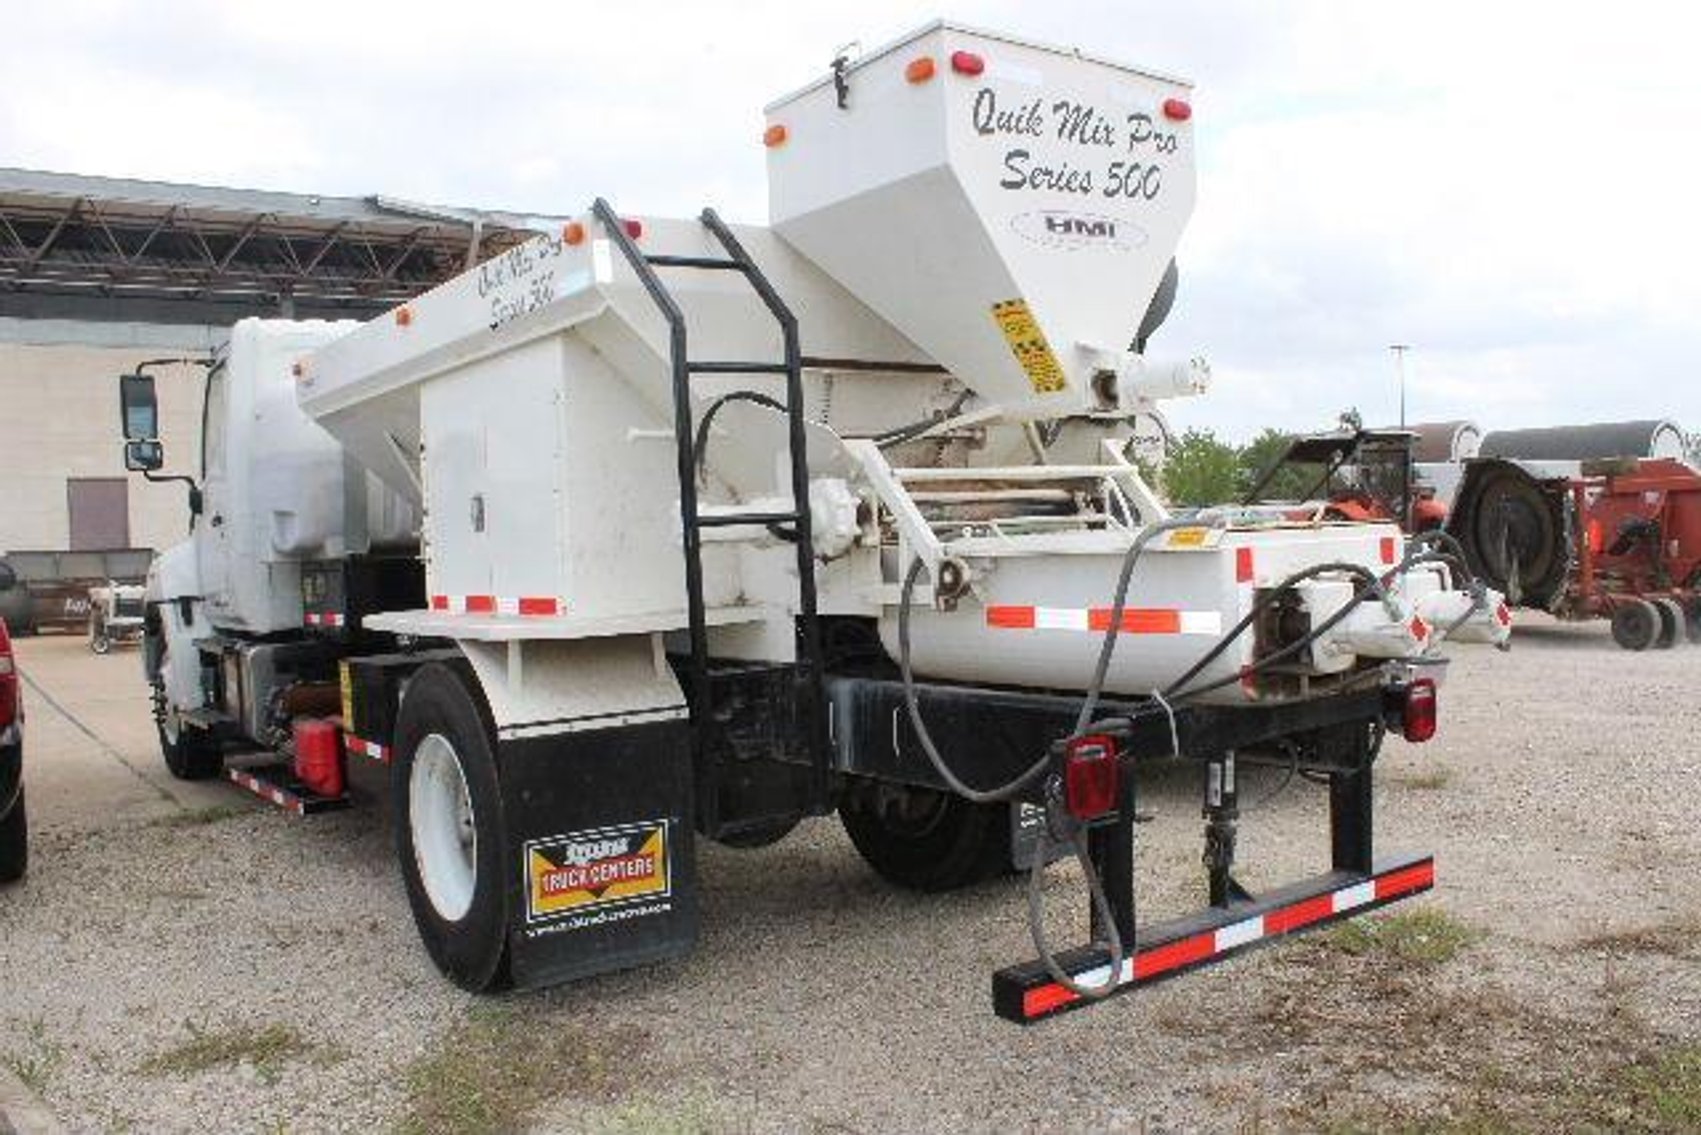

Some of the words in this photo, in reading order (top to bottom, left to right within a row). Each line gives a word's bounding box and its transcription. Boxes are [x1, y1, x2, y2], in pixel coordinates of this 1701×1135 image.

[972, 87, 1044, 136] Quik
[1052, 100, 1116, 147] Mix
[1127, 112, 1178, 155] Pro
[1000, 148, 1093, 195] Series
[1103, 161, 1161, 200] 500
[1045, 216, 1115, 238] HMI
[542, 867, 588, 892] TRUCK
[590, 857, 654, 885] CENTERS
